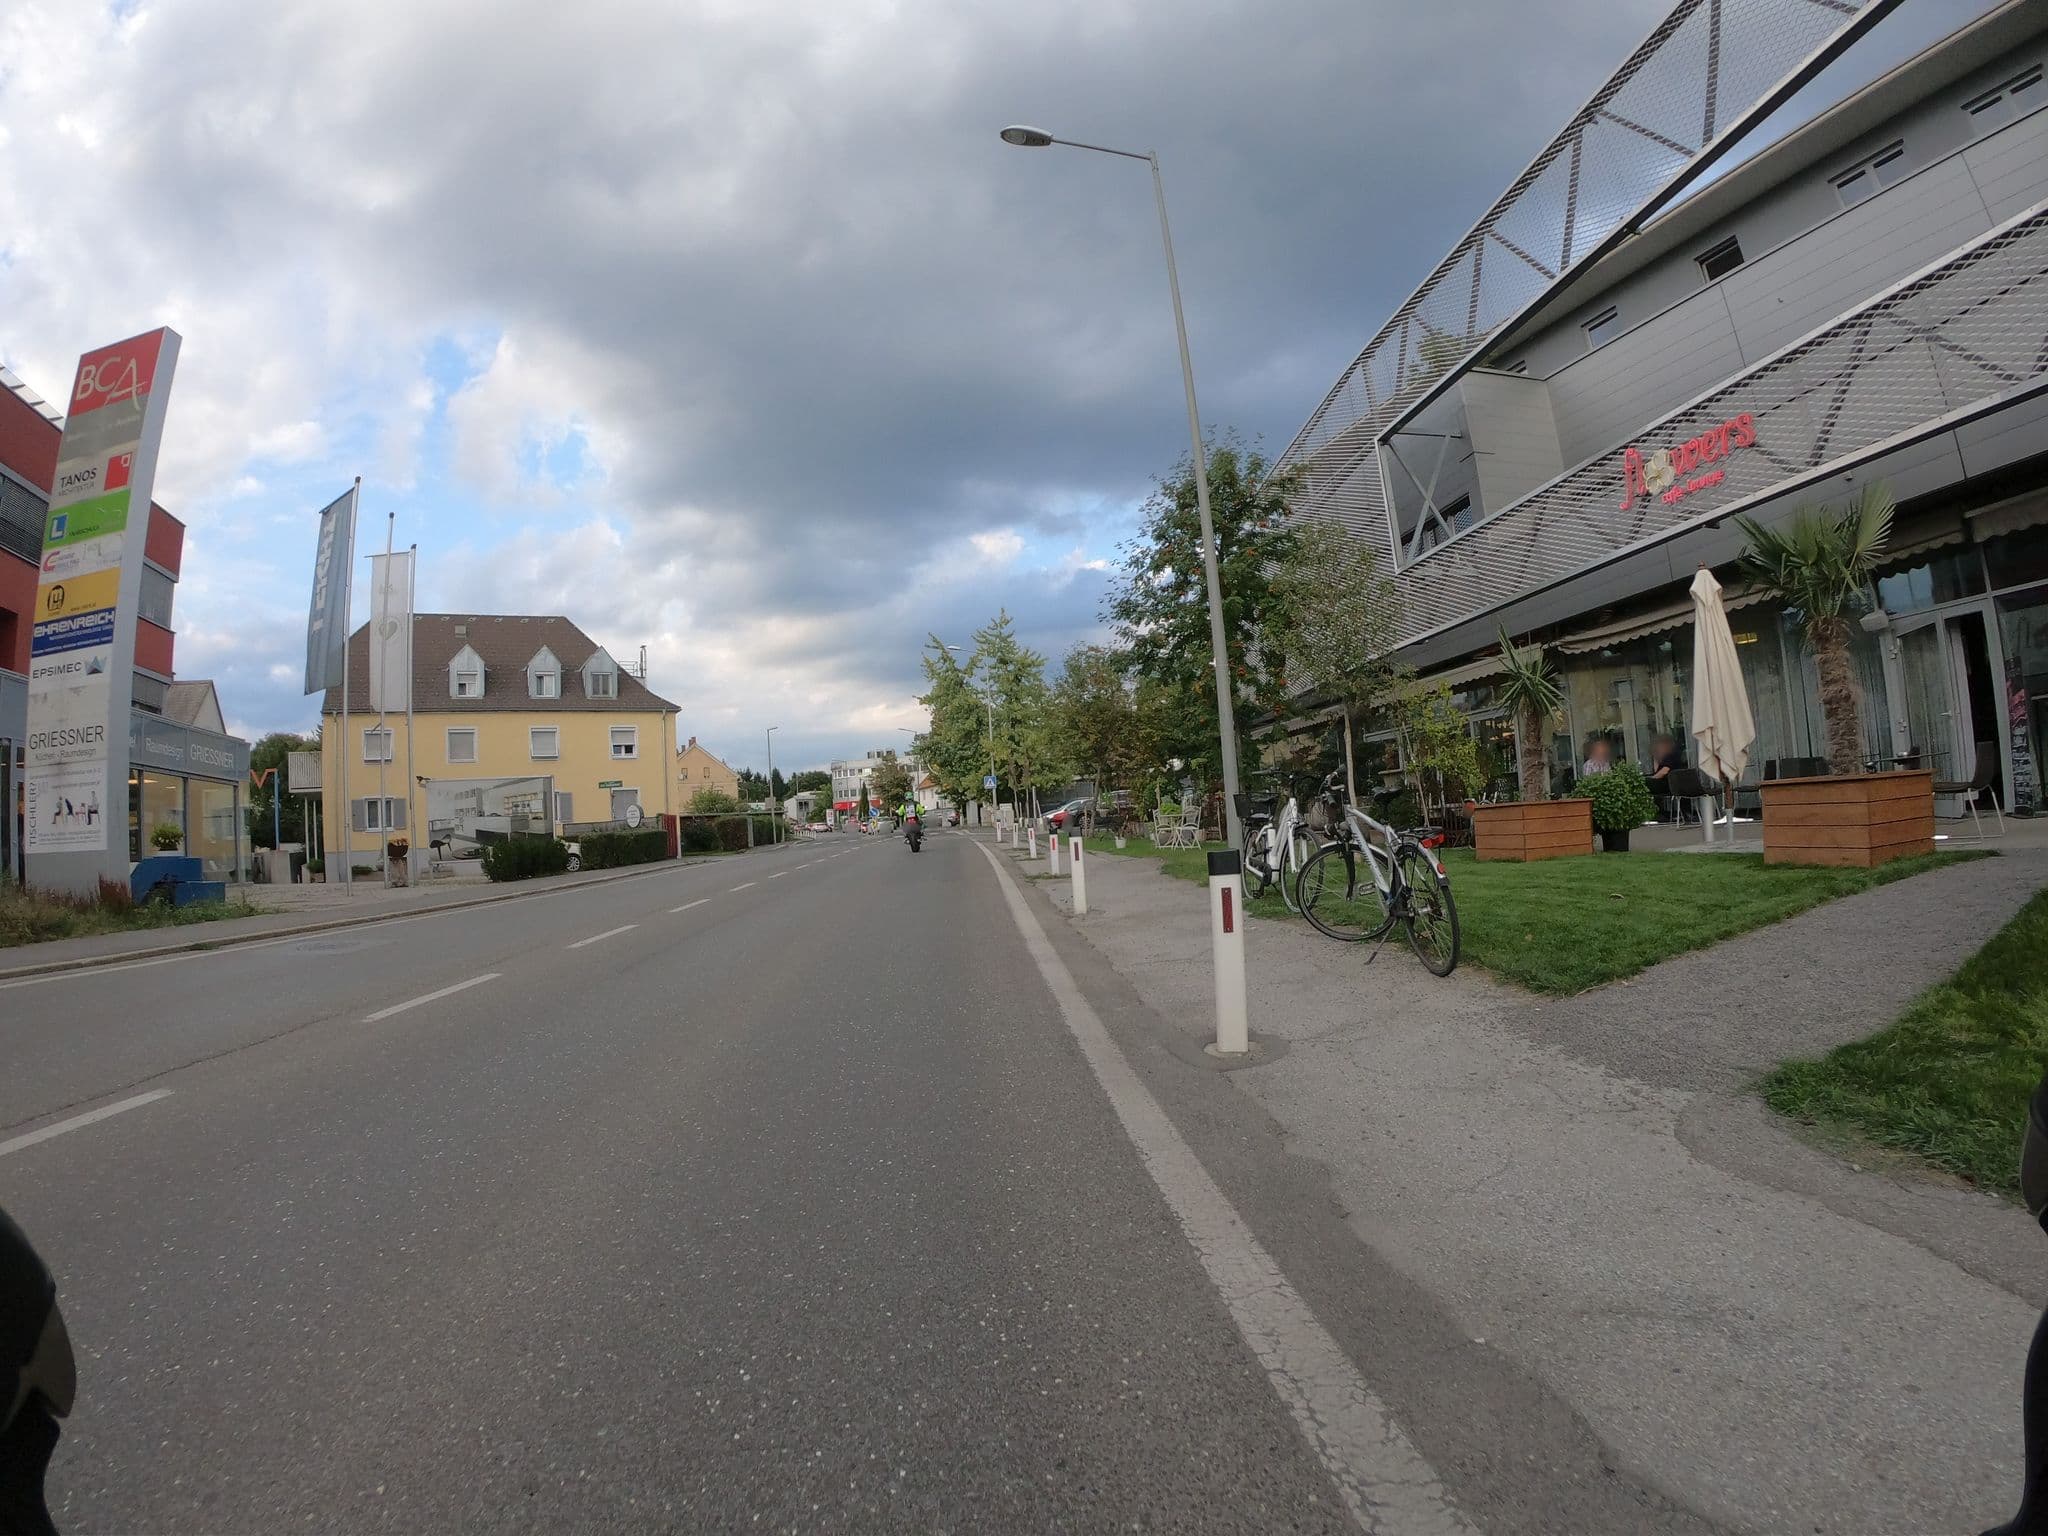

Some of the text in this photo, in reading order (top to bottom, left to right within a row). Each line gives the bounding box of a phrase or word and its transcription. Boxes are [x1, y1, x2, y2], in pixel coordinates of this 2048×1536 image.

[76, 356, 148, 410] BCA
[60, 467, 97, 488] TANOS
[33, 661, 82, 679] EPSIMEC
[29, 725, 104, 750] GRIESSNER
[190, 743, 234, 769] GRIESSNER
[29, 782, 37, 847] TISCHLER?
